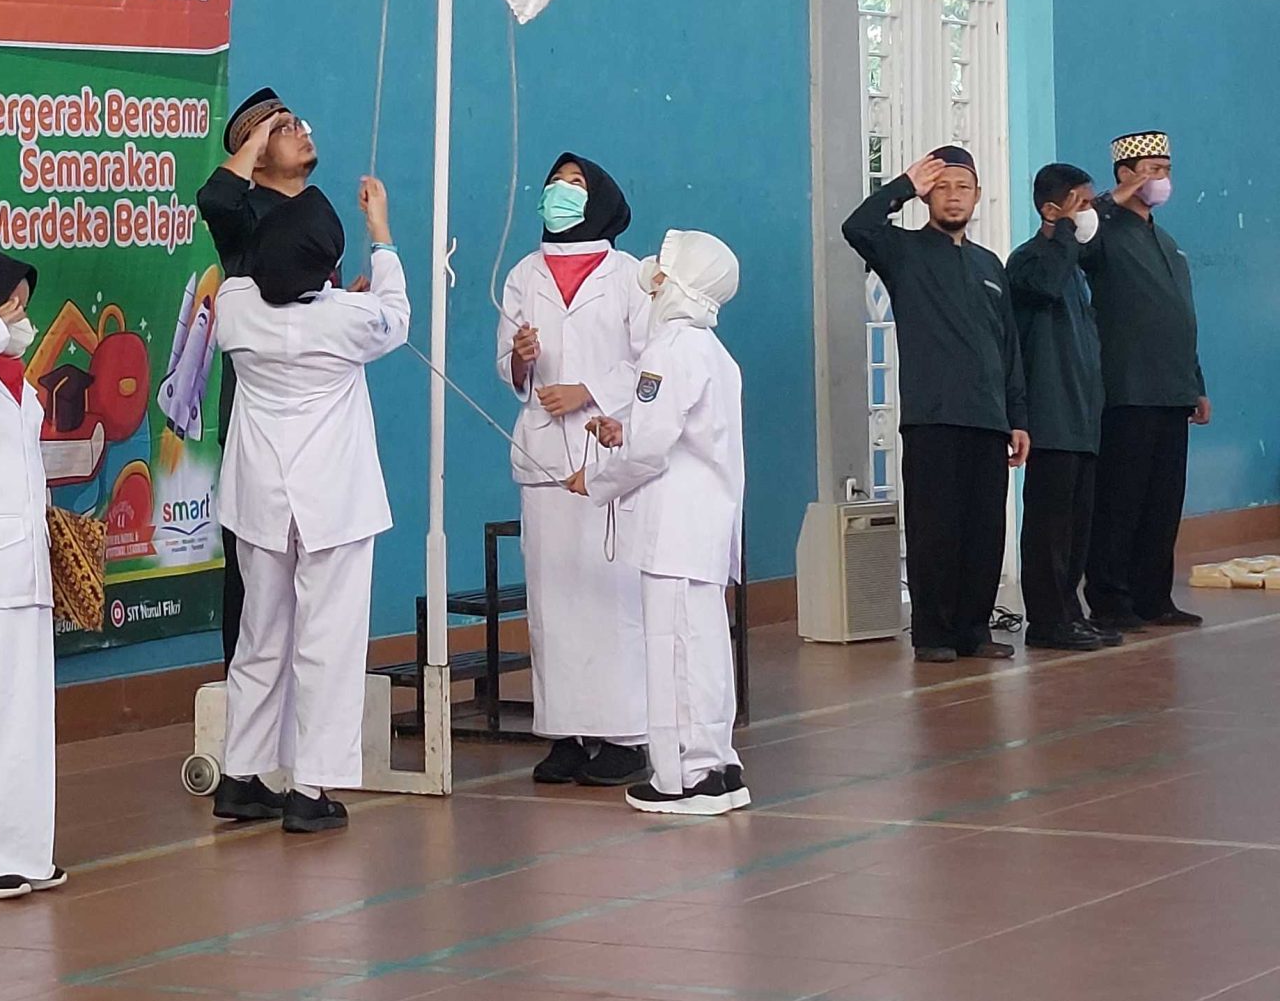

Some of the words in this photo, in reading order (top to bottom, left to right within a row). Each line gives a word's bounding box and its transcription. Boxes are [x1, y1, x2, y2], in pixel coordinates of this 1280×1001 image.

[106, 91, 209, 136] Bersama
[22, 144, 174, 190] Semarakan
[115, 195, 196, 253] Belajar
[162, 493, 210, 523] smart
[127, 605, 140, 622] SIT
